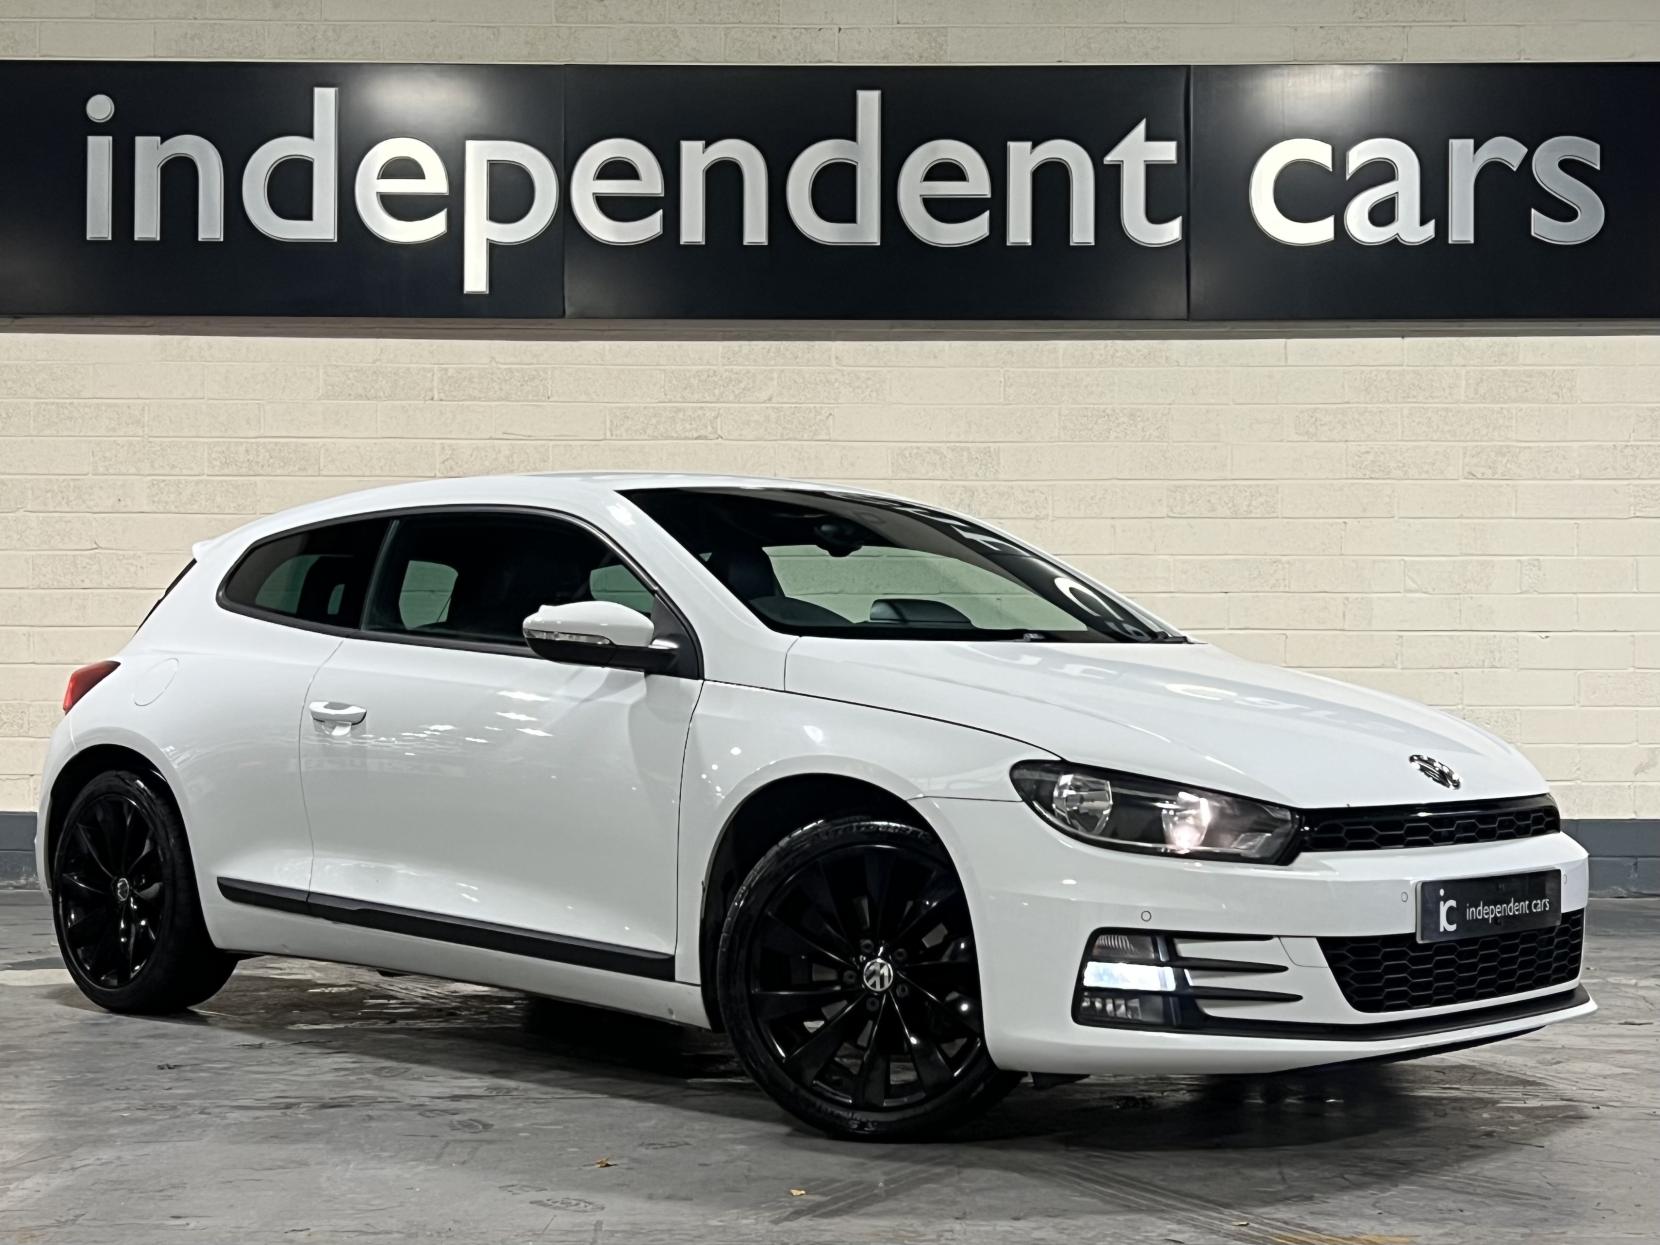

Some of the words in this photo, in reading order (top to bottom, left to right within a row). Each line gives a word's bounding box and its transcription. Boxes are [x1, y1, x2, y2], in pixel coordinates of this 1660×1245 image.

[85, 86, 1183, 295] independent
[1248, 134, 1606, 247] cars
[1439, 888, 1457, 932] ic
[1466, 897, 1529, 923] independent
[1531, 898, 1550, 912] cars
